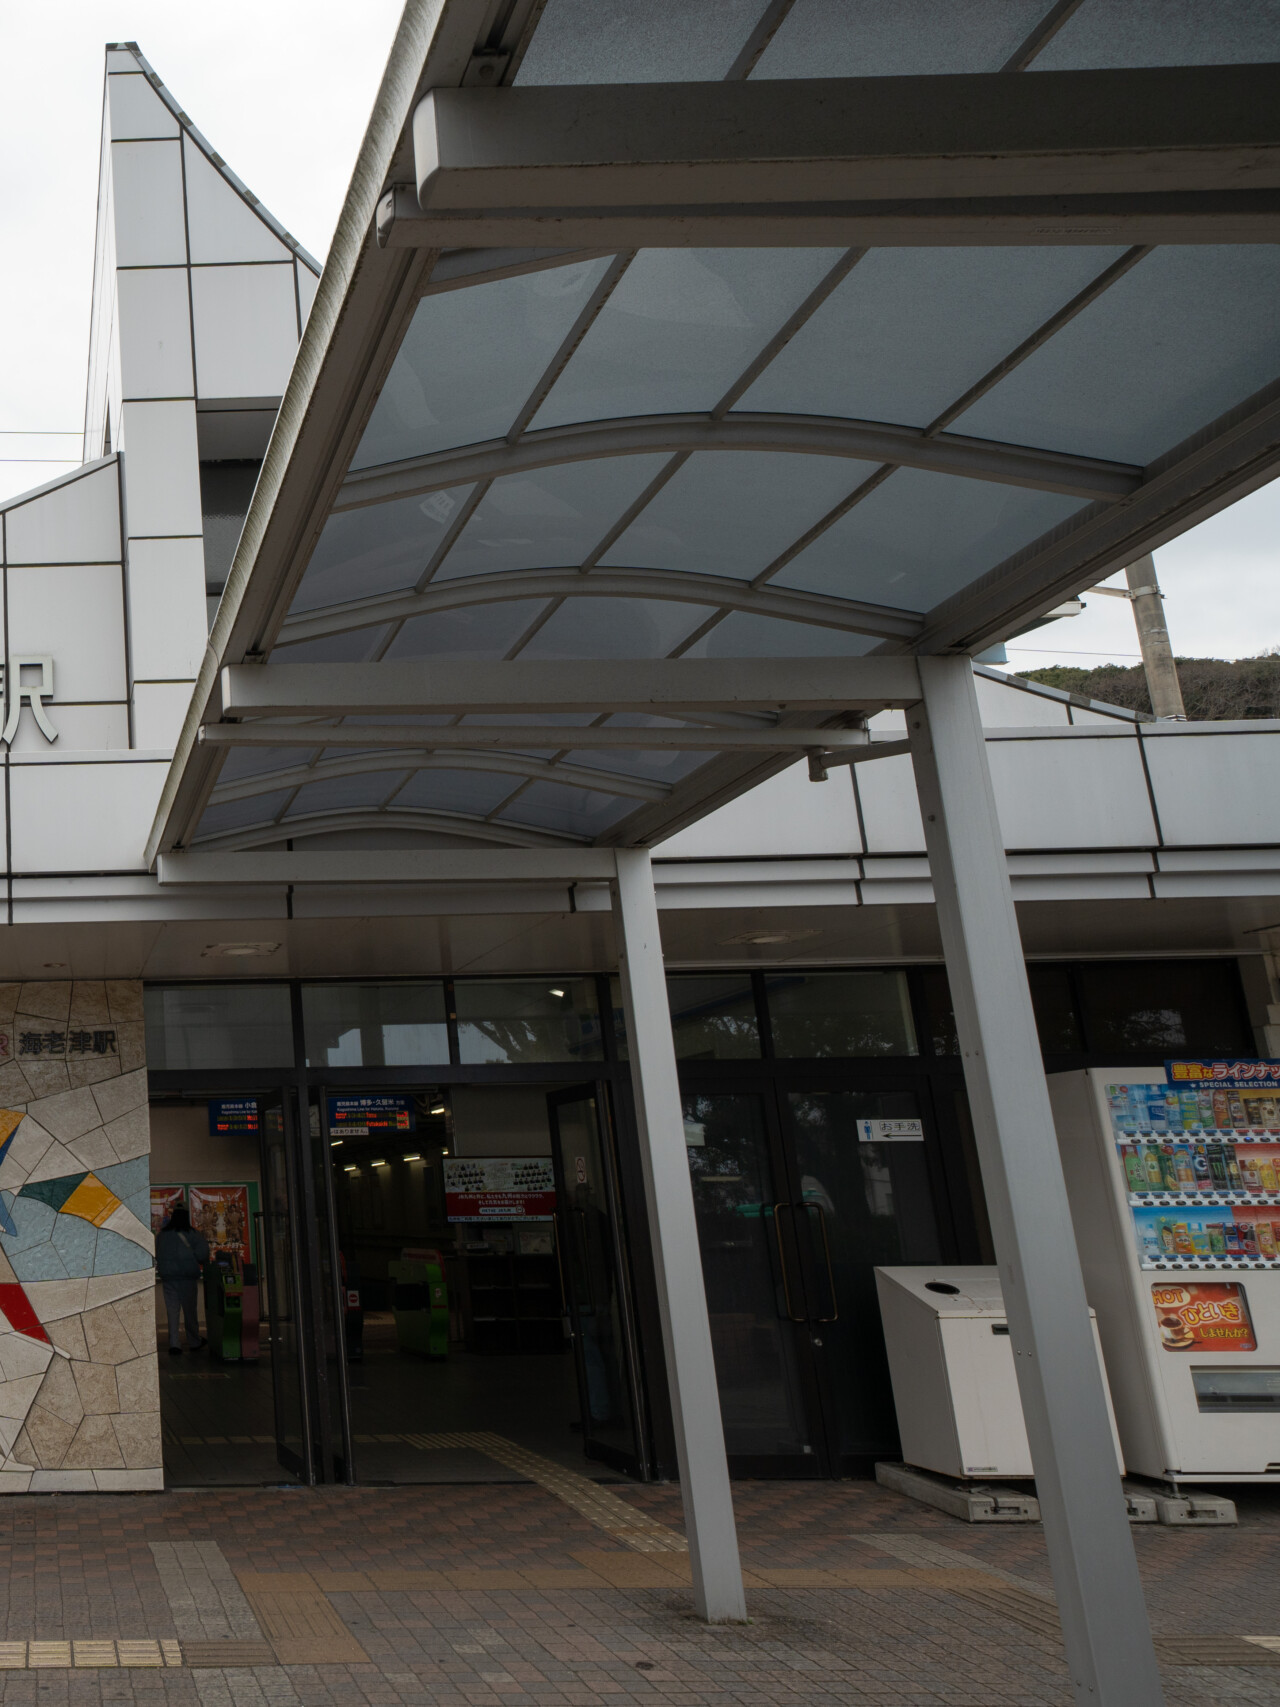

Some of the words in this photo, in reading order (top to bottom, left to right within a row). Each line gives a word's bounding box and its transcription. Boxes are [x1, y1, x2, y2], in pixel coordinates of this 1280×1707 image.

[19, 1030, 116, 1055] 海老津駅
[881, 1122, 920, 1131] お手洗
[1151, 1288, 1185, 1305] HOT
[1180, 1300, 1240, 1326] ひといき
